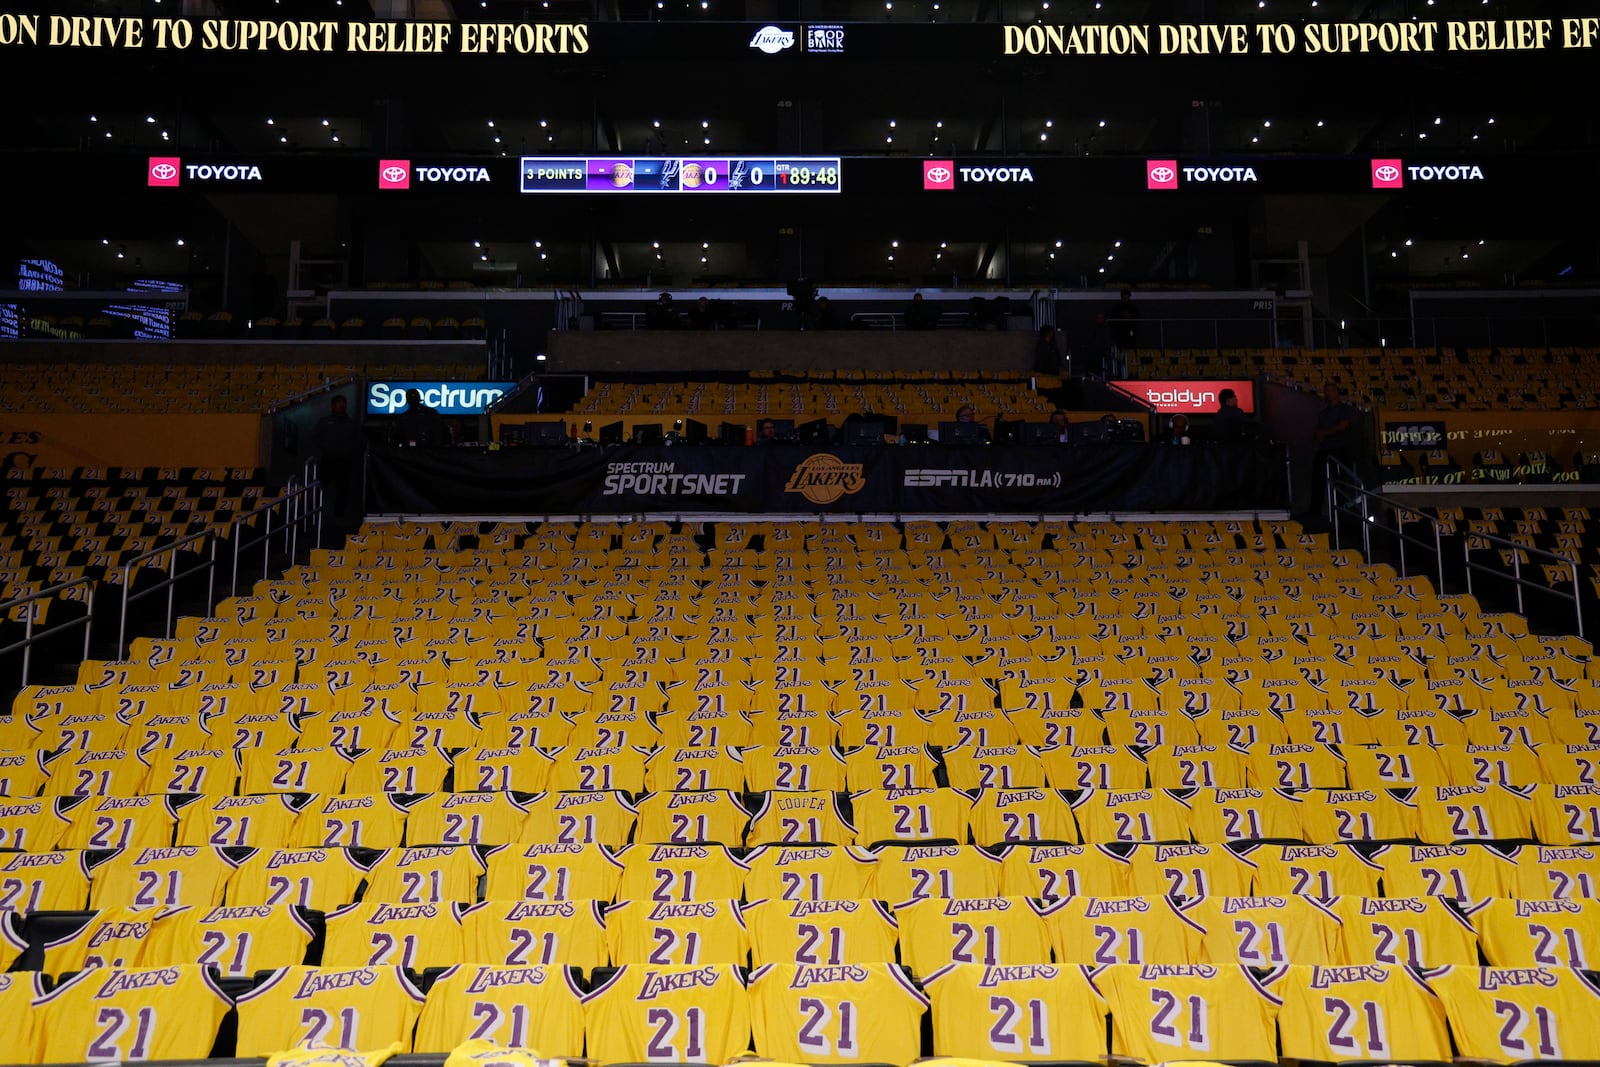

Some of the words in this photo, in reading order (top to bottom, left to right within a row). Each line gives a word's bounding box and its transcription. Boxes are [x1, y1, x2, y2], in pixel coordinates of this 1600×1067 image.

[0, 14, 40, 45] ON
[49, 16, 143, 48] DRIVE
[153, 18, 193, 49] TO
[201, 19, 339, 52] SUPPORT
[347, 22, 451, 53] RELIEF
[460, 23, 589, 54] EFFORTS
[1004, 25, 1149, 55] DONATION
[1158, 24, 1249, 54] DRIVE
[1256, 23, 1296, 54] TO
[1303, 21, 1438, 54] SUPPORT
[1446, 19, 1553, 51] RELIEF
[1561, 17, 1600, 49] EF
[186, 164, 263, 181] TOYOTA
[415, 167, 491, 183] TOYOTA
[527, 169, 534, 180] 3
[537, 168, 583, 180] POINTS
[704, 167, 717, 185] 0
[750, 167, 763, 185] 0
[780, 173, 788, 185] 1
[789, 167, 837, 185] 89:48
[959, 167, 1034, 183] TOYOTA
[1182, 167, 1258, 183] TOYOTA
[1407, 166, 1484, 181] TOYOTA
[1146, 388, 1215, 407] boldyn
[607, 461, 675, 474] SPECTRUM
[792, 467, 861, 491] LAKERS
[903, 469, 969, 487] ESPN
[1004, 473, 1035, 487] 710
[602, 473, 746, 496] SPORTSNET
[43, 557, 60, 567] 21
[329, 556, 344, 567] 21
[774, 605, 794, 615] 21
[1227, 622, 1248, 636] 21
[1356, 622, 1378, 636] 21
[102, 670, 128, 685] 21
[254, 670, 278, 683] 21
[776, 666, 800, 681] 21
[119, 699, 146, 718] 21
[201, 696, 227, 713] 21
[698, 694, 724, 711] 21
[860, 694, 887, 710] 21
[1269, 692, 1294, 709] 21
[145, 714, 191, 727] LAKERS
[778, 710, 818, 720] LAKERS
[1312, 721, 1340, 740] 21
[168, 765, 205, 792] 21
[272, 760, 308, 789] 21
[95, 794, 152, 811] LAKERS
[778, 797, 826, 810] COOPER
[210, 816, 250, 846] 21
[443, 814, 484, 844] 21
[670, 814, 709, 843] 21
[782, 818, 821, 842] 21
[894, 805, 935, 838] 21
[1113, 812, 1155, 842] 21
[1223, 808, 1264, 839] 21
[1447, 805, 1493, 836] 21
[90, 817, 134, 849] 21
[1, 849, 68, 872] LAKERS
[266, 849, 329, 870] LAKERS
[649, 844, 710, 861] LAKERS
[775, 847, 832, 866] LAKERS
[902, 846, 959, 862] LAKERS
[1030, 845, 1087, 863] LAKERS
[1154, 844, 1209, 861] LAKERS
[1280, 845, 1338, 861] LAKERS
[1409, 845, 1469, 862] LAKERS
[1538, 846, 1595, 864] LAKERS
[135, 869, 181, 906] 21
[266, 876, 312, 909] 21
[402, 869, 441, 902] 21
[525, 864, 571, 901] 21
[652, 868, 698, 901] 21
[782, 872, 824, 901] 21
[911, 868, 954, 899] 21
[1039, 868, 1083, 899] 21
[1165, 868, 1208, 899] 21
[1291, 867, 1329, 900] 21
[1421, 868, 1469, 902] 21
[1548, 869, 1596, 900] 21
[0, 878, 44, 913] 21
[944, 898, 1012, 916] LAKERS
[1222, 897, 1288, 914] LAKERS
[1360, 897, 1427, 916] LAKERS
[200, 905, 274, 923] LAKERS
[368, 902, 439, 924] LAKERS
[504, 901, 576, 921] LAKERS
[648, 901, 719, 921] LAKERS
[790, 899, 859, 917] LAKERS
[1084, 897, 1150, 918] LAKERS
[1515, 899, 1582, 917] LAKERS
[198, 931, 254, 976] 21
[369, 932, 418, 968] 21
[505, 928, 560, 965] 21
[650, 927, 702, 965] 21
[797, 923, 848, 965] 21
[952, 922, 1000, 965] 21
[1094, 925, 1144, 965] 21
[1234, 919, 1287, 966] 21
[1371, 922, 1422, 967] 21
[1529, 923, 1588, 968] 21
[95, 966, 181, 999] LAKERS
[294, 967, 380, 999] LAKERS
[466, 965, 549, 993] LAKERS
[637, 965, 720, 1000] LAKERS
[789, 964, 868, 988] LAKERS
[978, 965, 1059, 987] LAKERS
[1310, 965, 1391, 989] LAKERS
[1479, 966, 1558, 991] LAKERS
[467, 1001, 529, 1048] 21
[798, 998, 858, 1058] 21
[989, 996, 1051, 1055] 21
[1150, 988, 1209, 1052] 21
[1325, 997, 1390, 1060] 21
[1495, 998, 1563, 1060] 21
[87, 1006, 157, 1061] 21
[647, 1006, 708, 1062] 21
